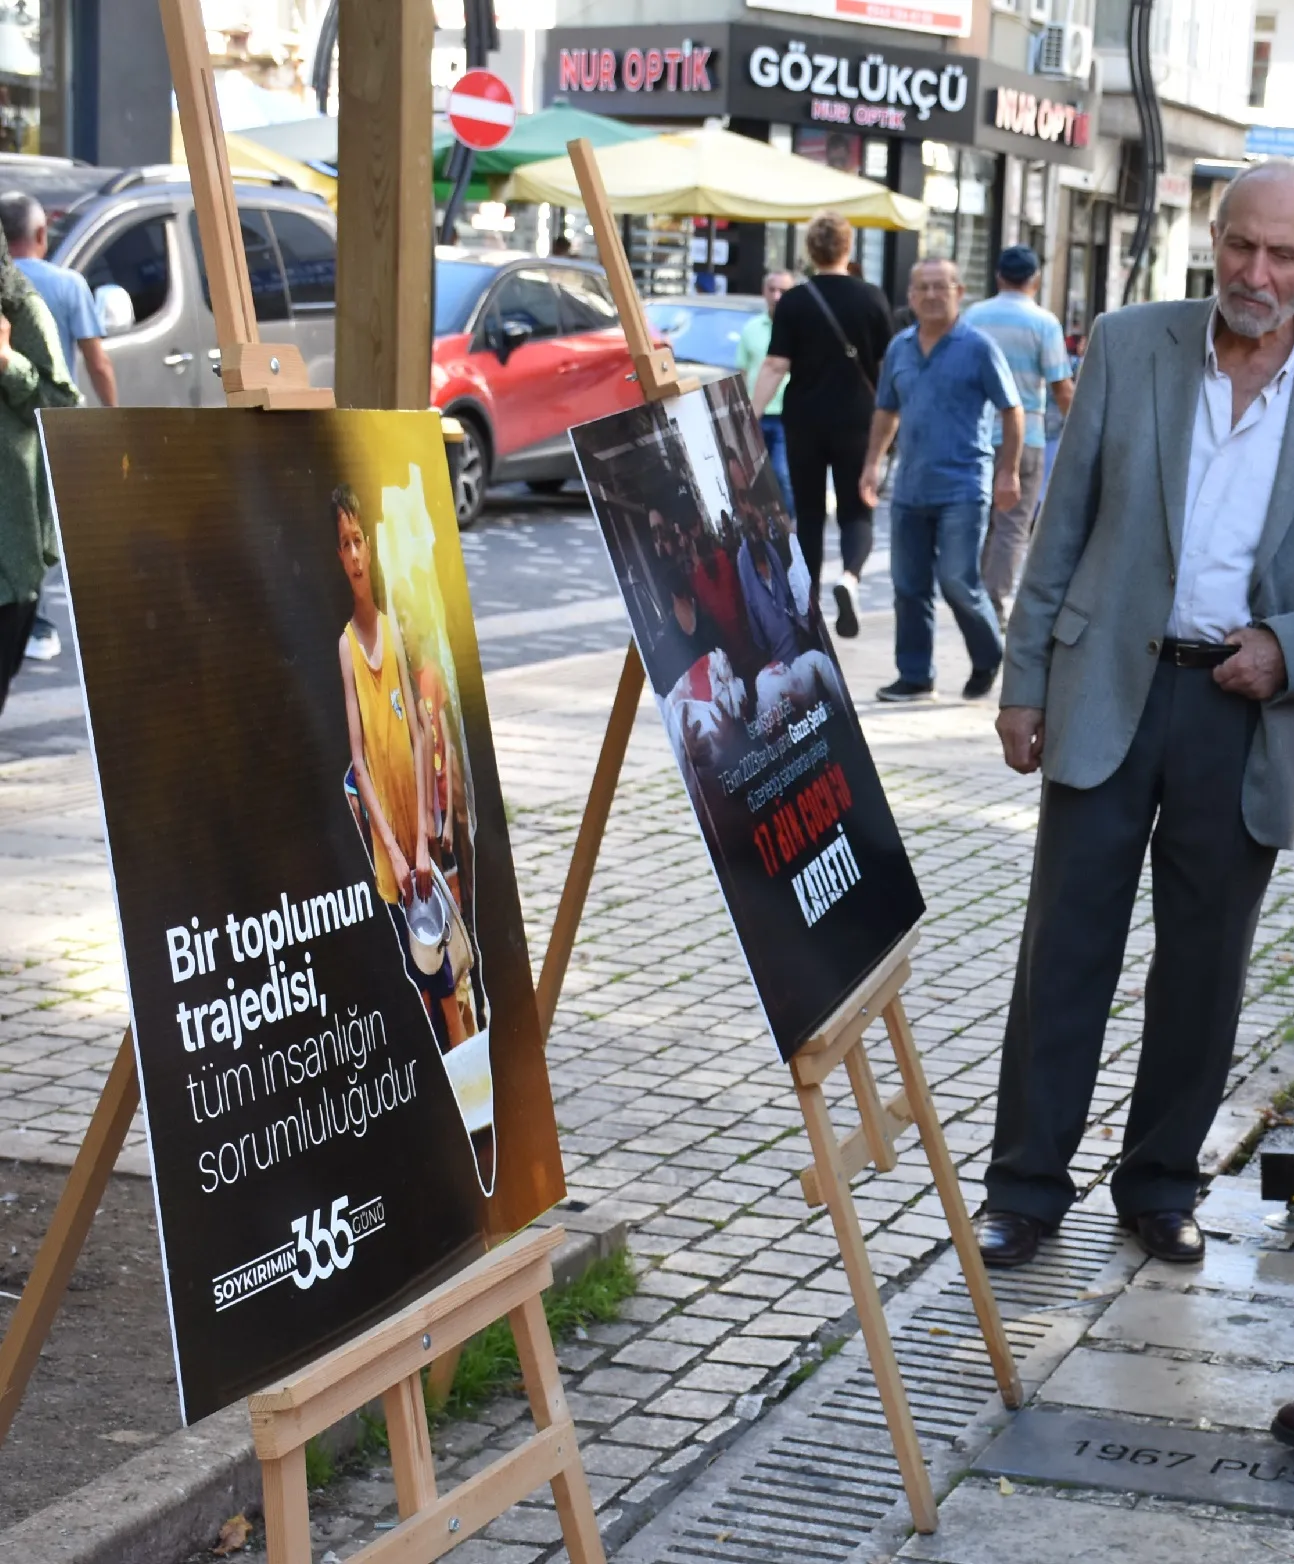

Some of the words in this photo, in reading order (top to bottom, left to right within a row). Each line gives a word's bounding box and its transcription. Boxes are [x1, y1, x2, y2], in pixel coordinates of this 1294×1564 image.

[560, 48, 616, 92] NUR
[622, 38, 712, 92] OPTİK
[749, 41, 968, 120] GÖZLÜKÇÜ
[811, 98, 850, 124] NUR
[853, 104, 907, 131] OPTİK
[996, 86, 1037, 136] NUR
[788, 717, 811, 744] Gazze
[753, 822, 780, 879] 17
[791, 822, 862, 928] KATLETTİ
[166, 916, 219, 983] Bir
[225, 881, 374, 966] toplumun
[176, 952, 327, 1052] trajedisi,
[186, 1063, 256, 1123] tüm
[259, 1004, 388, 1096] insanlığın
[199, 1057, 417, 1193] sorumluluğudur
[213, 1248, 298, 1305] SOYKIRIMIN
[291, 1195, 355, 1290] 365
[352, 1202, 385, 1234] GÜNÜ
[1073, 1438, 1197, 1469] 1967
